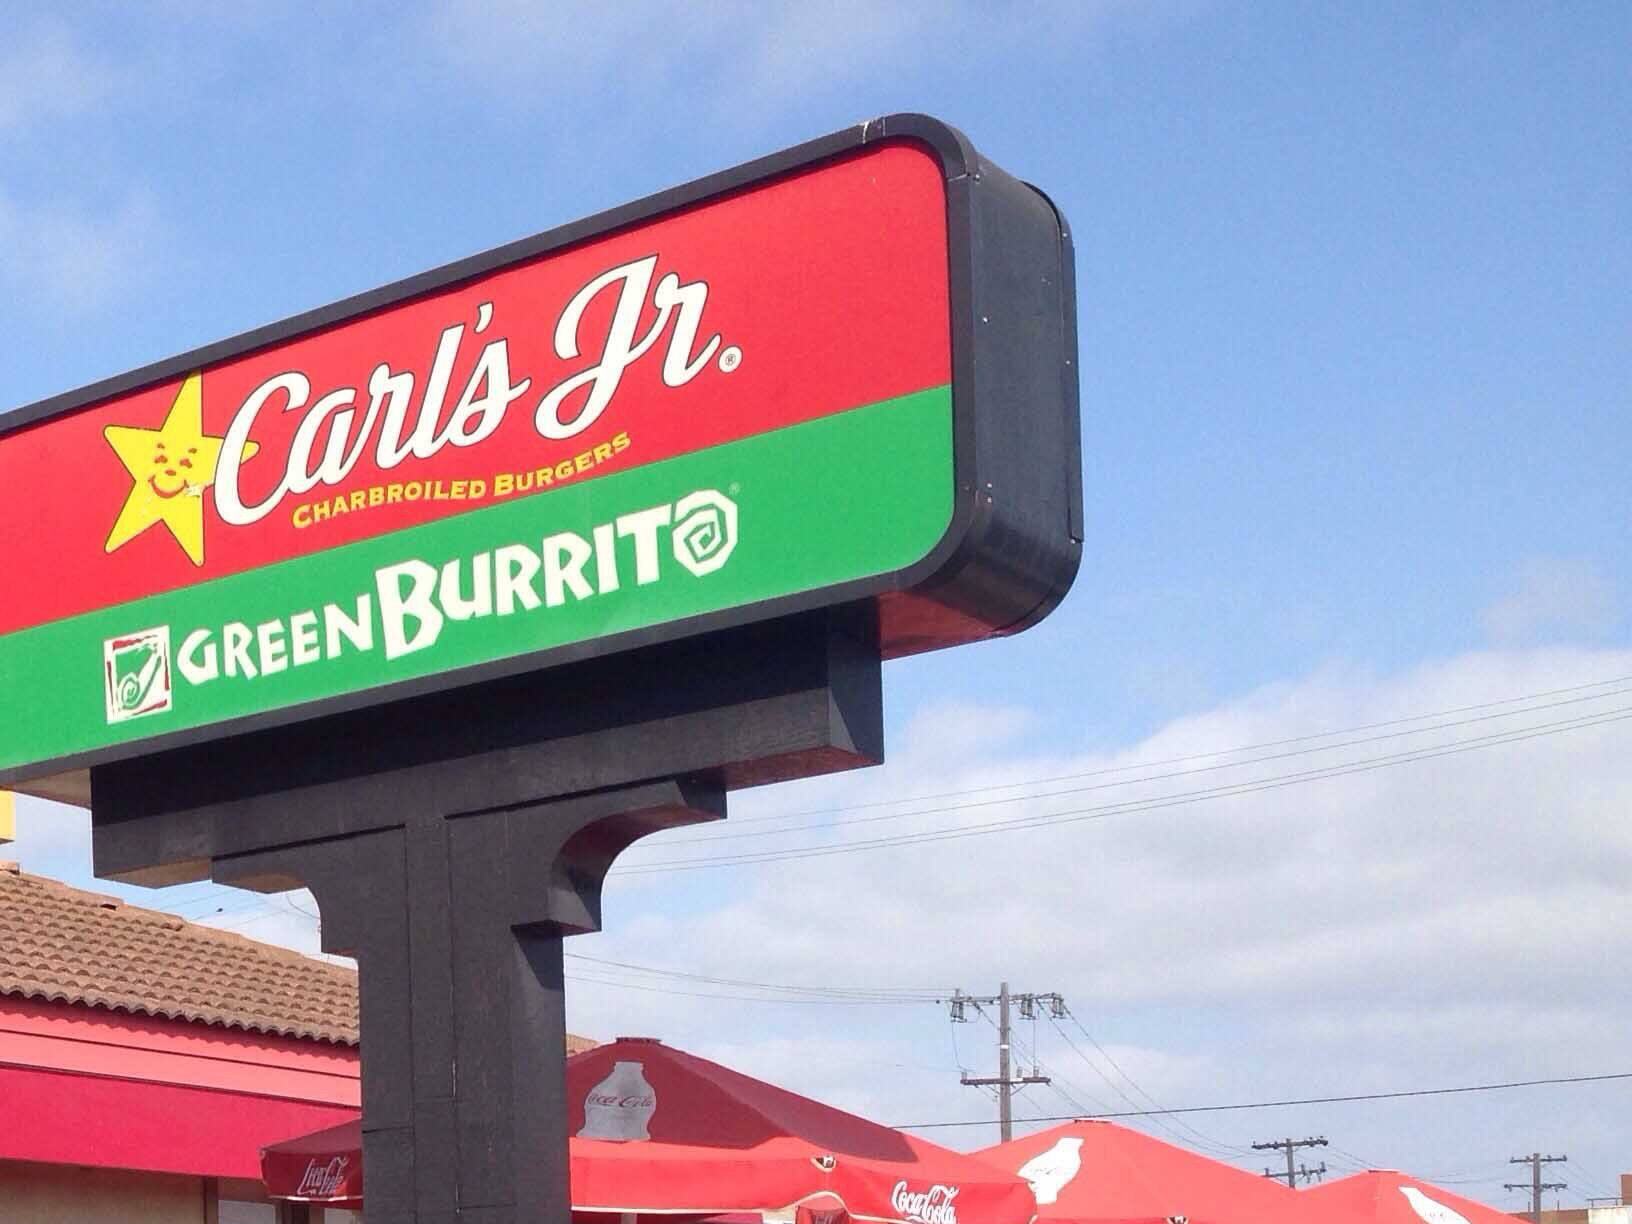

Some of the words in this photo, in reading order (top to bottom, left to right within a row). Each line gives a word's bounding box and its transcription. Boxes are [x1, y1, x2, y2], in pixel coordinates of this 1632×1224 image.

[212, 301, 531, 527] Carl's
[534, 253, 743, 441] Jr.
[292, 480, 486, 529] CHARBROILED
[493, 432, 631, 497] BURGERS
